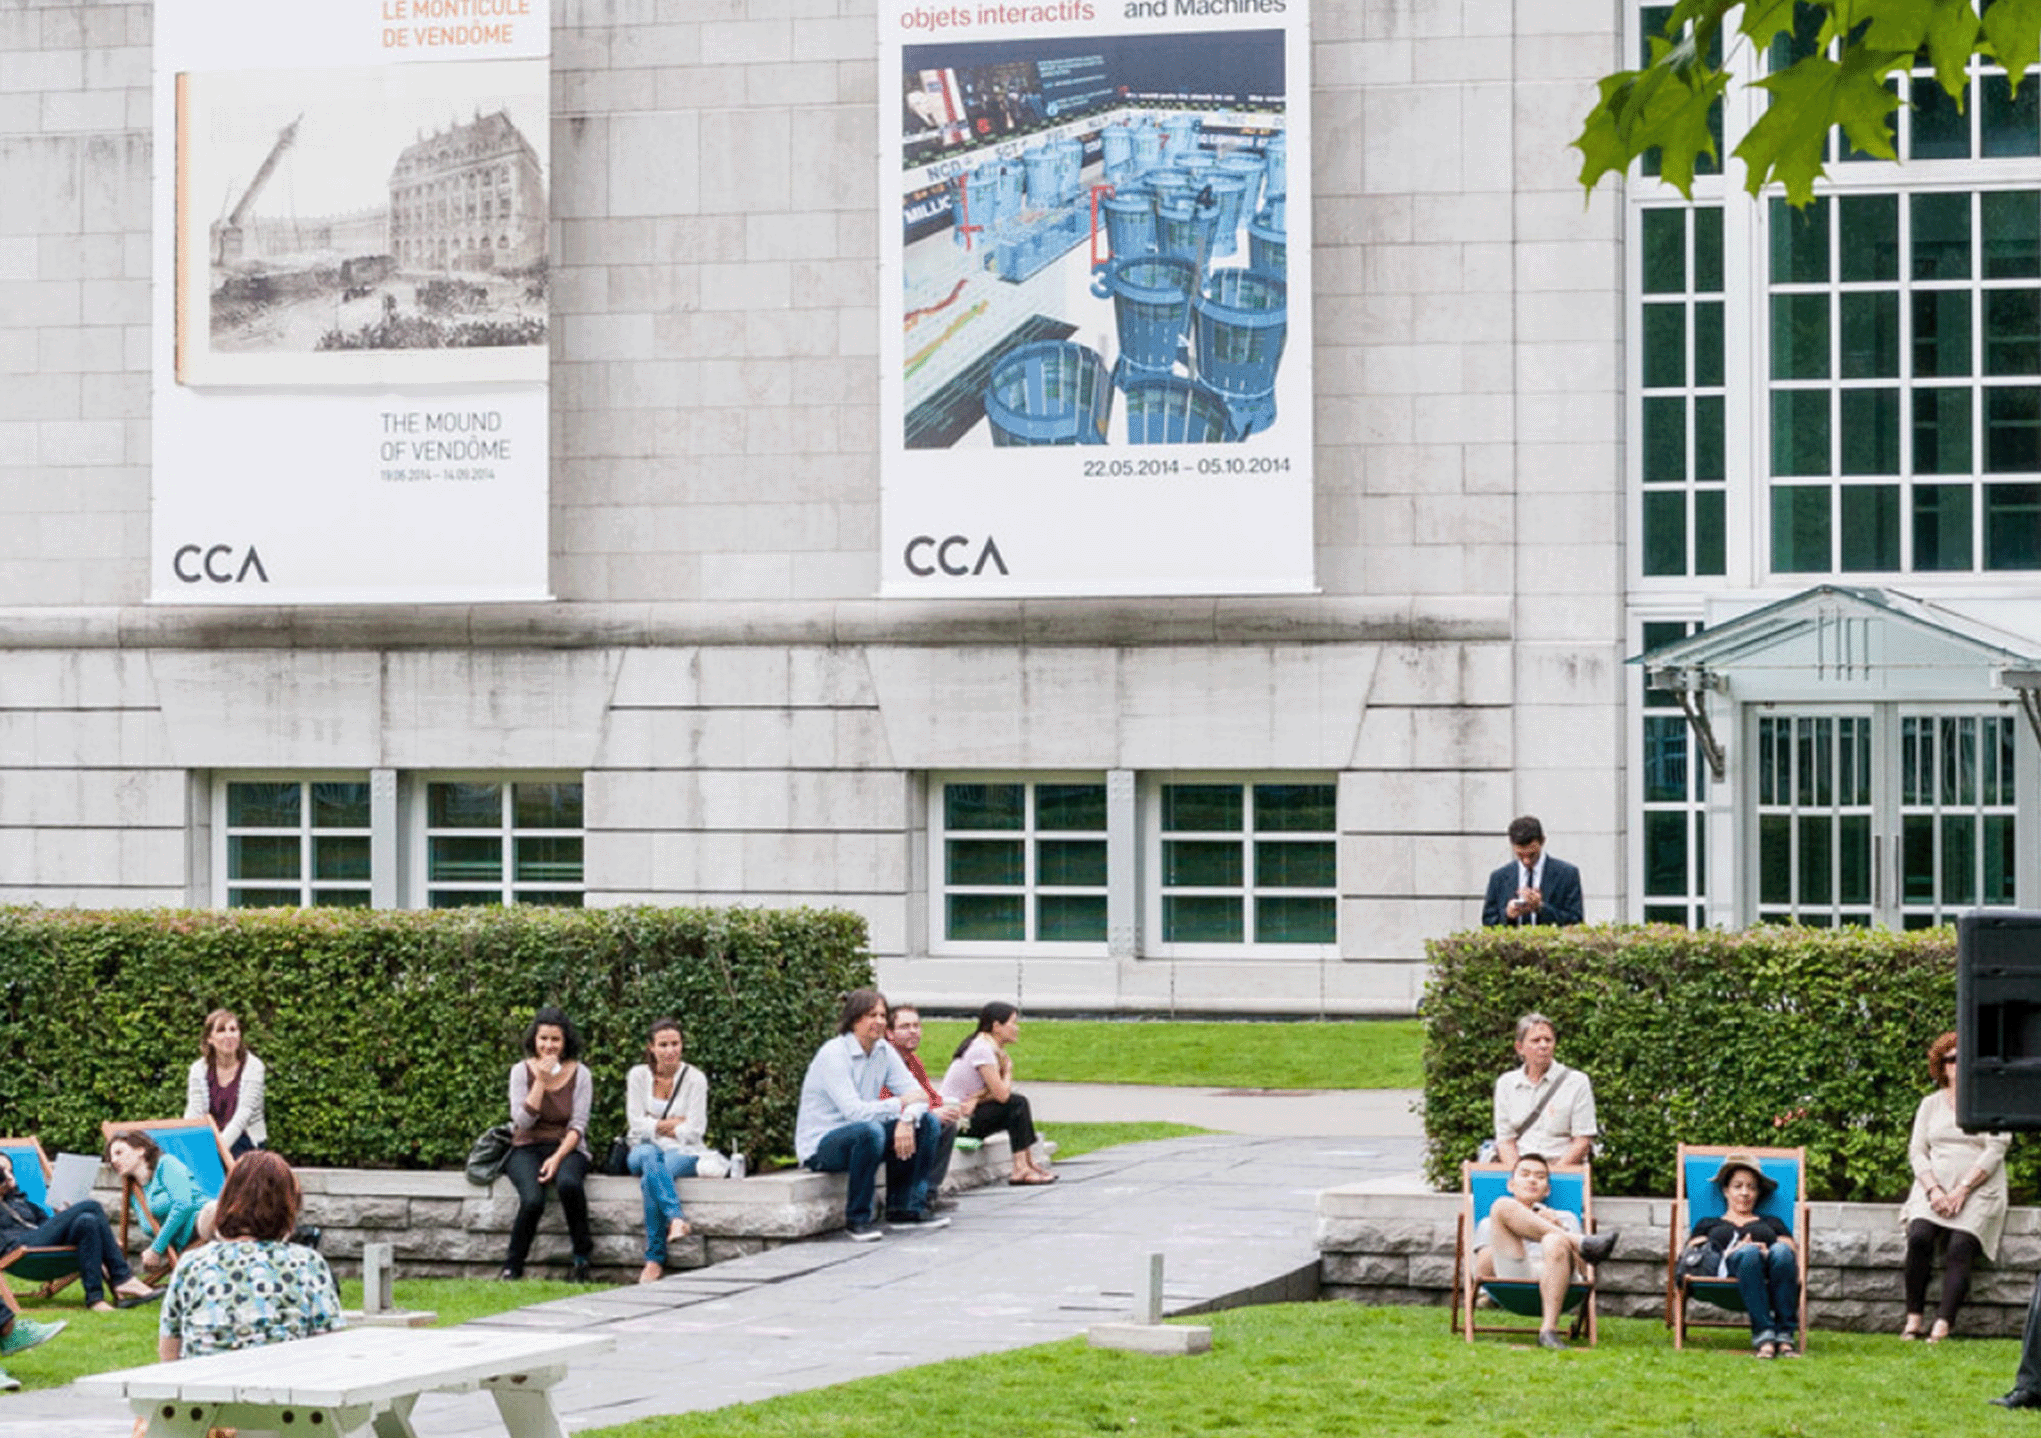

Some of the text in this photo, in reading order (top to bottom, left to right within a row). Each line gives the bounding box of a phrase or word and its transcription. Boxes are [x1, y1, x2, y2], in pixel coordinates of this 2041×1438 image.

[382, 0, 531, 20] LE MONTICULE
[901, 1, 1096, 31] objets interactifs
[1123, 0, 1287, 18] and Machines
[382, 19, 513, 48] DE VENDÔME
[381, 411, 502, 434] THE MOUND
[380, 434, 511, 462] OF VENDÔME
[1083, 459, 1180, 477] 22.05.2014
[1197, 457, 1291, 475] 05.10.2014
[173, 544, 270, 584] CCA
[903, 534, 1010, 576] CCA
